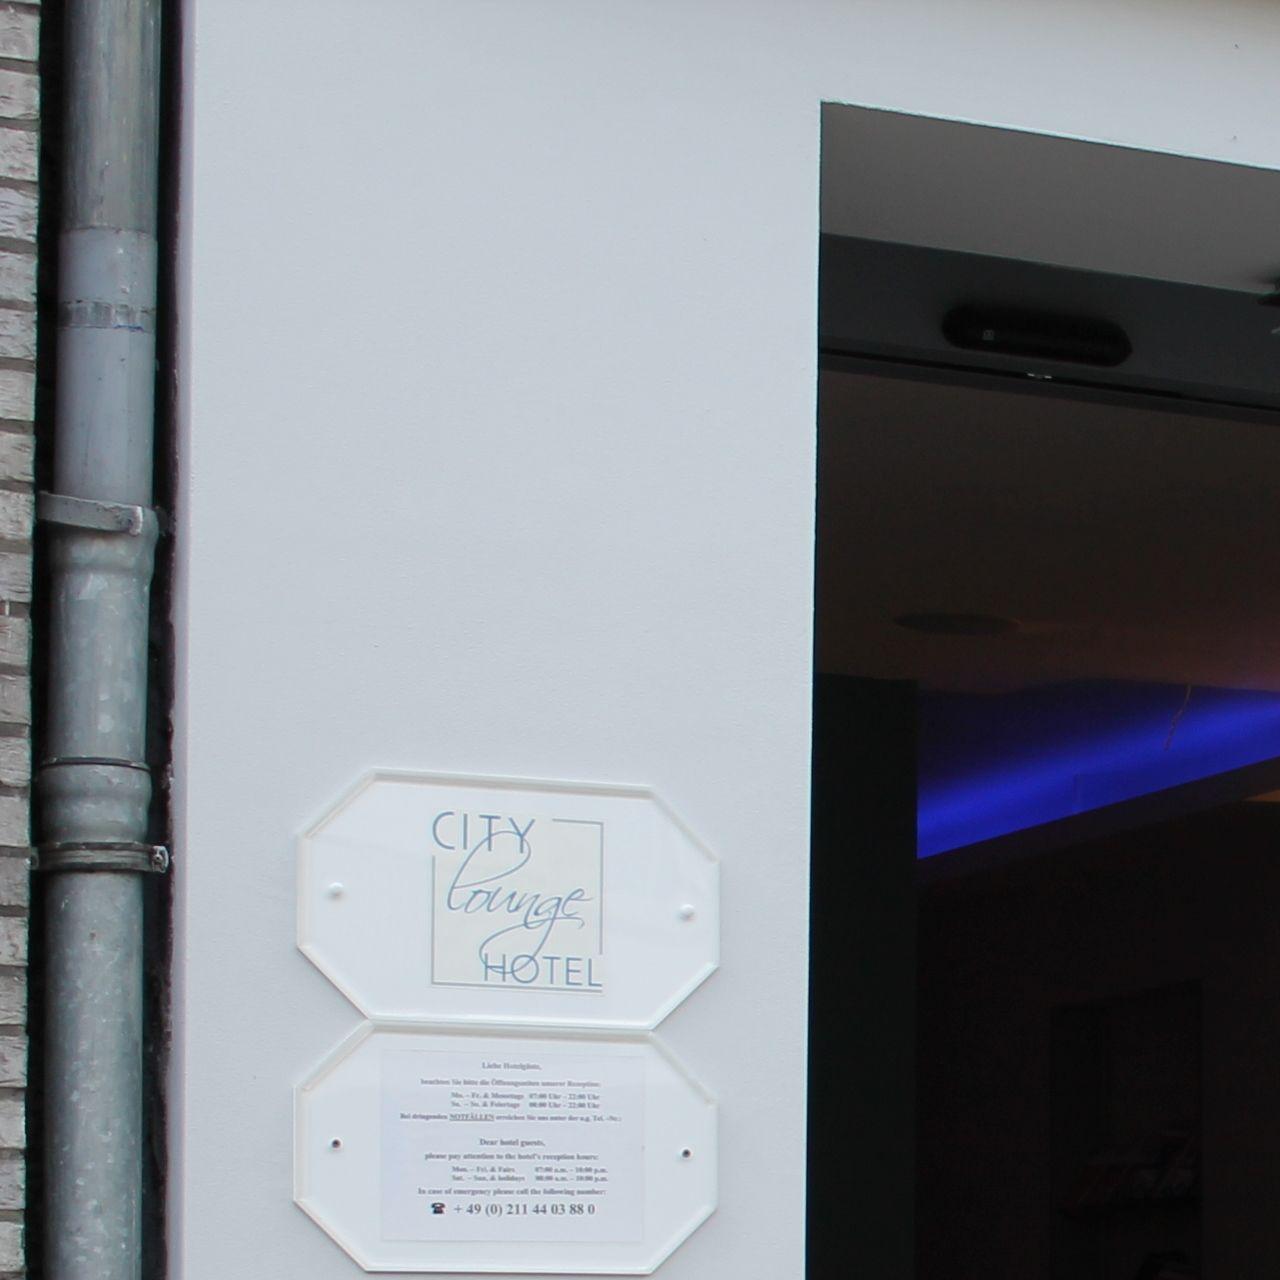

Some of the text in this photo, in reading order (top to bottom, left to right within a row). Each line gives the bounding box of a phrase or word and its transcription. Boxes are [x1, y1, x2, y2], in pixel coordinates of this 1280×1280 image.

[432, 811, 536, 854] CITY
[484, 953, 603, 987] HOTEL
[466, 1203, 482, 1214] 49
[485, 1203, 503, 1217] (0)
[506, 1203, 528, 1215] 211
[532, 1203, 547, 1215] 44
[551, 1203, 566, 1215] 03
[569, 1203, 584, 1215] 88
[587, 1203, 596, 1215] 0
